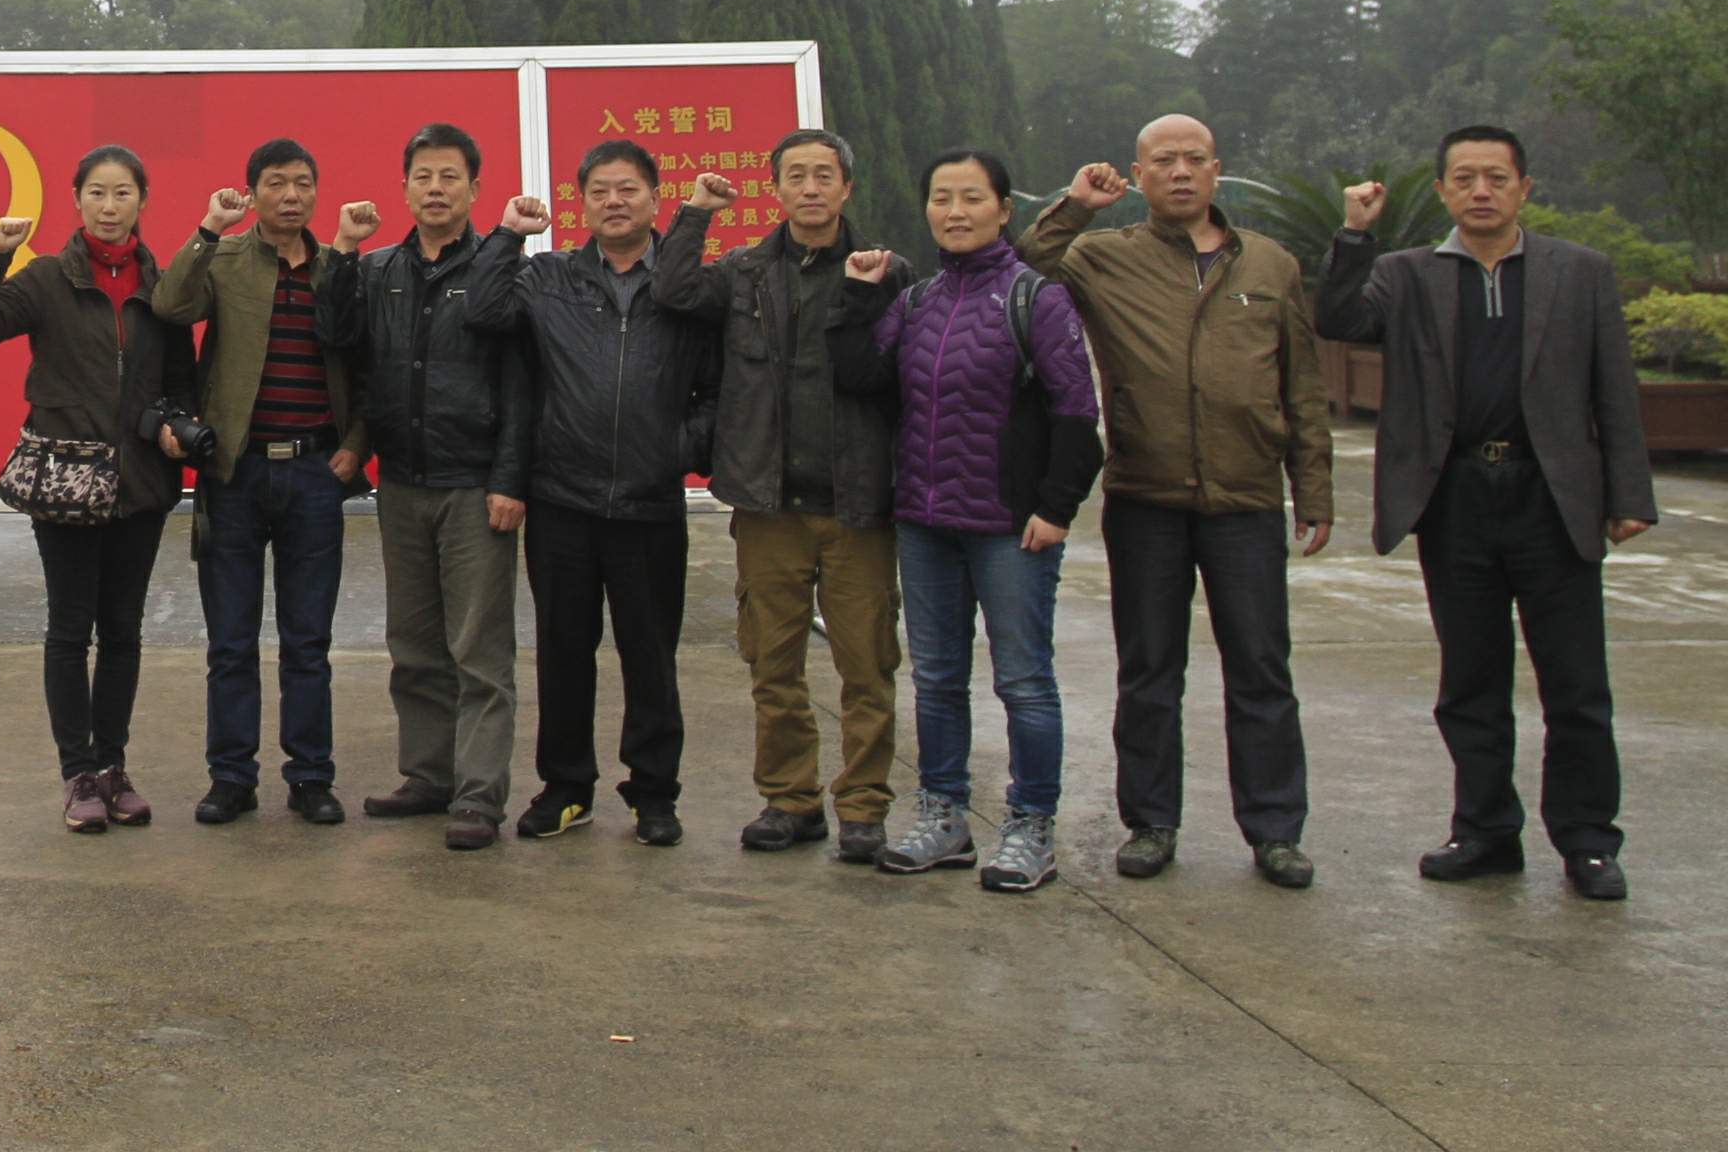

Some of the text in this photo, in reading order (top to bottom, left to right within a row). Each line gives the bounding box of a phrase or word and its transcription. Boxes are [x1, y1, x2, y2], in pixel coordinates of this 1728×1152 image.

[598, 106, 733, 135] 入党誓词
[651, 151, 772, 170] 加入中国共产
